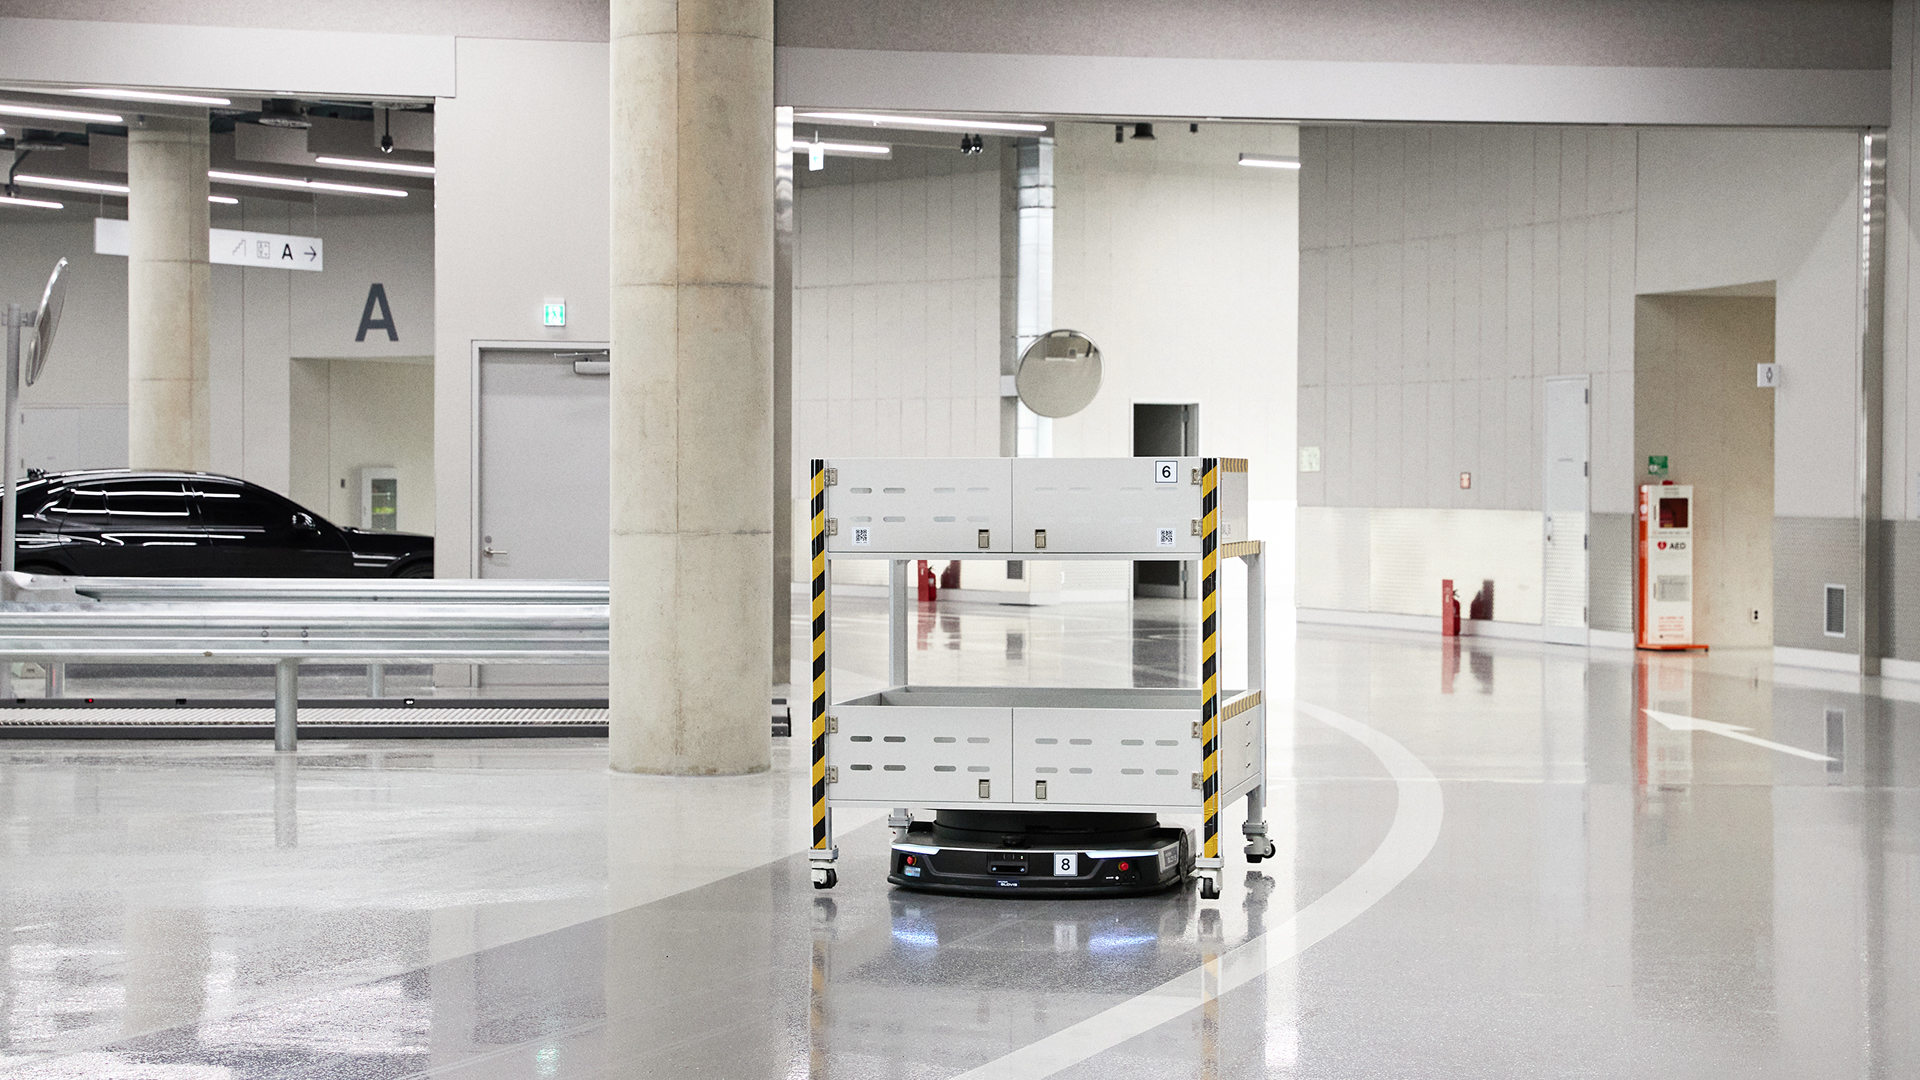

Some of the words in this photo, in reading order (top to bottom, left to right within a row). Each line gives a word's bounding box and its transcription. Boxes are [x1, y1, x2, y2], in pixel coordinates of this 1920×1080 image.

[282, 243, 294, 260] A
[355, 283, 399, 342] A
[1162, 465, 1171, 479] 6
[1669, 542, 1686, 550] AED
[1061, 858, 1070, 871] 8
